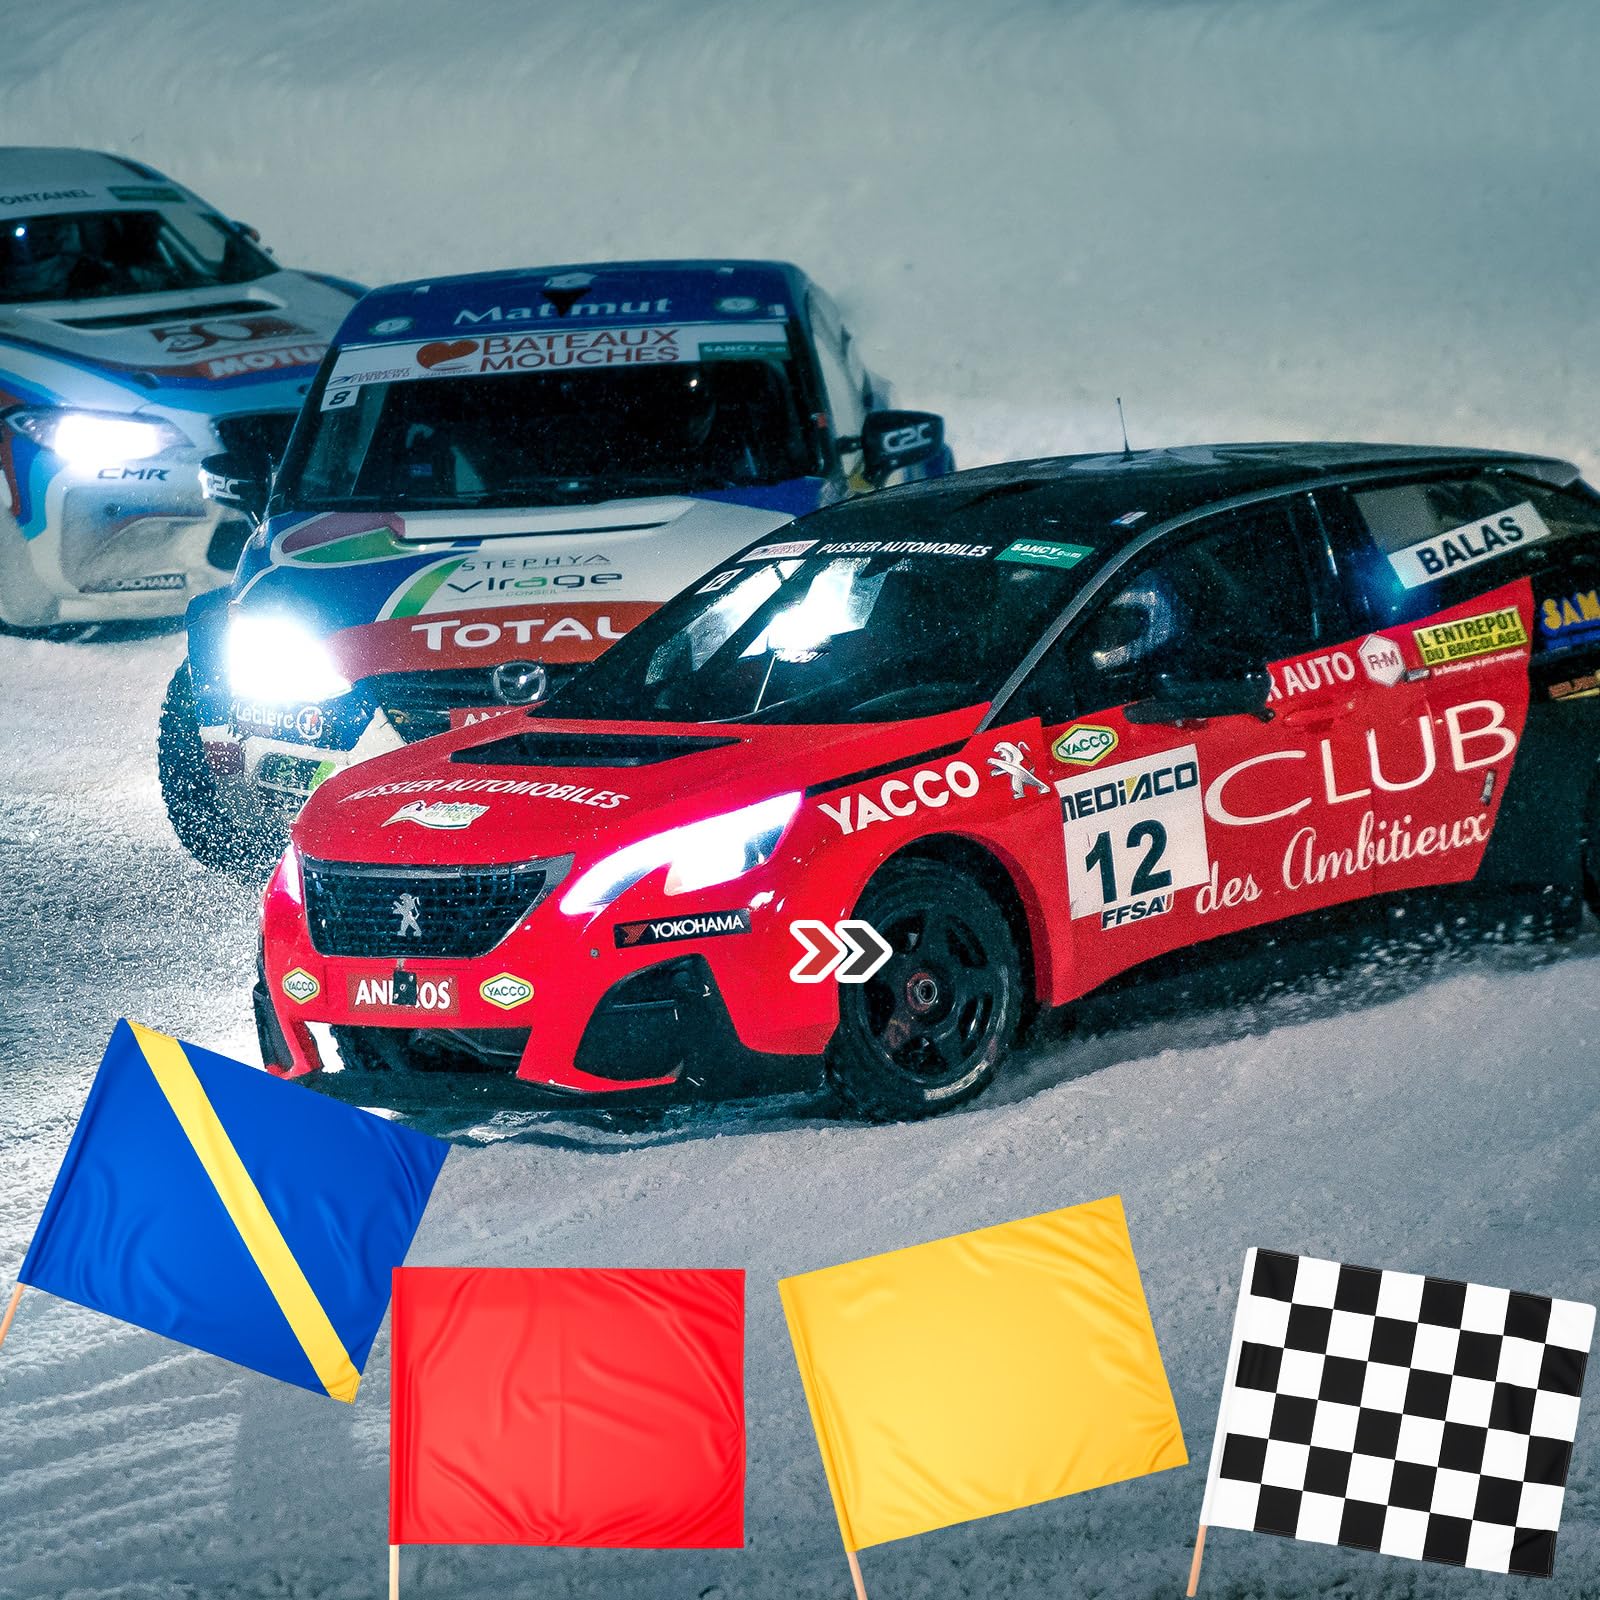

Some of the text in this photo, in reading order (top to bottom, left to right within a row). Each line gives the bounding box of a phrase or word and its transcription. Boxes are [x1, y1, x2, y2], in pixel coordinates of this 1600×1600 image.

[453, 299, 671, 325] Matmut
[482, 329, 681, 355] BATEAUX
[480, 347, 680, 372] MOUCHES
[329, 391, 351, 405] 8
[97, 468, 170, 481] CMR
[816, 541, 886, 555] PUSSIER
[885, 541, 992, 557] AUTOMOBILES
[1416, 516, 1524, 575] BALAS
[461, 554, 611, 572] STEPHYA
[411, 616, 627, 651] TOTAL
[1282, 651, 1356, 696] AUTO
[1061, 734, 1111, 755] YACCO
[1205, 699, 1516, 826] CLUB
[434, 779, 631, 809] AUTOMOBILES
[817, 761, 981, 836] YACCO
[1085, 819, 1173, 905] 12
[1195, 810, 1490, 914] des Ambitieux
[1102, 894, 1166, 929] FFSA
[650, 915, 745, 939] YOKOHAMA
[287, 980, 316, 992] YACCO
[355, 979, 451, 1010] ANOS
[486, 984, 527, 998] YACCO
